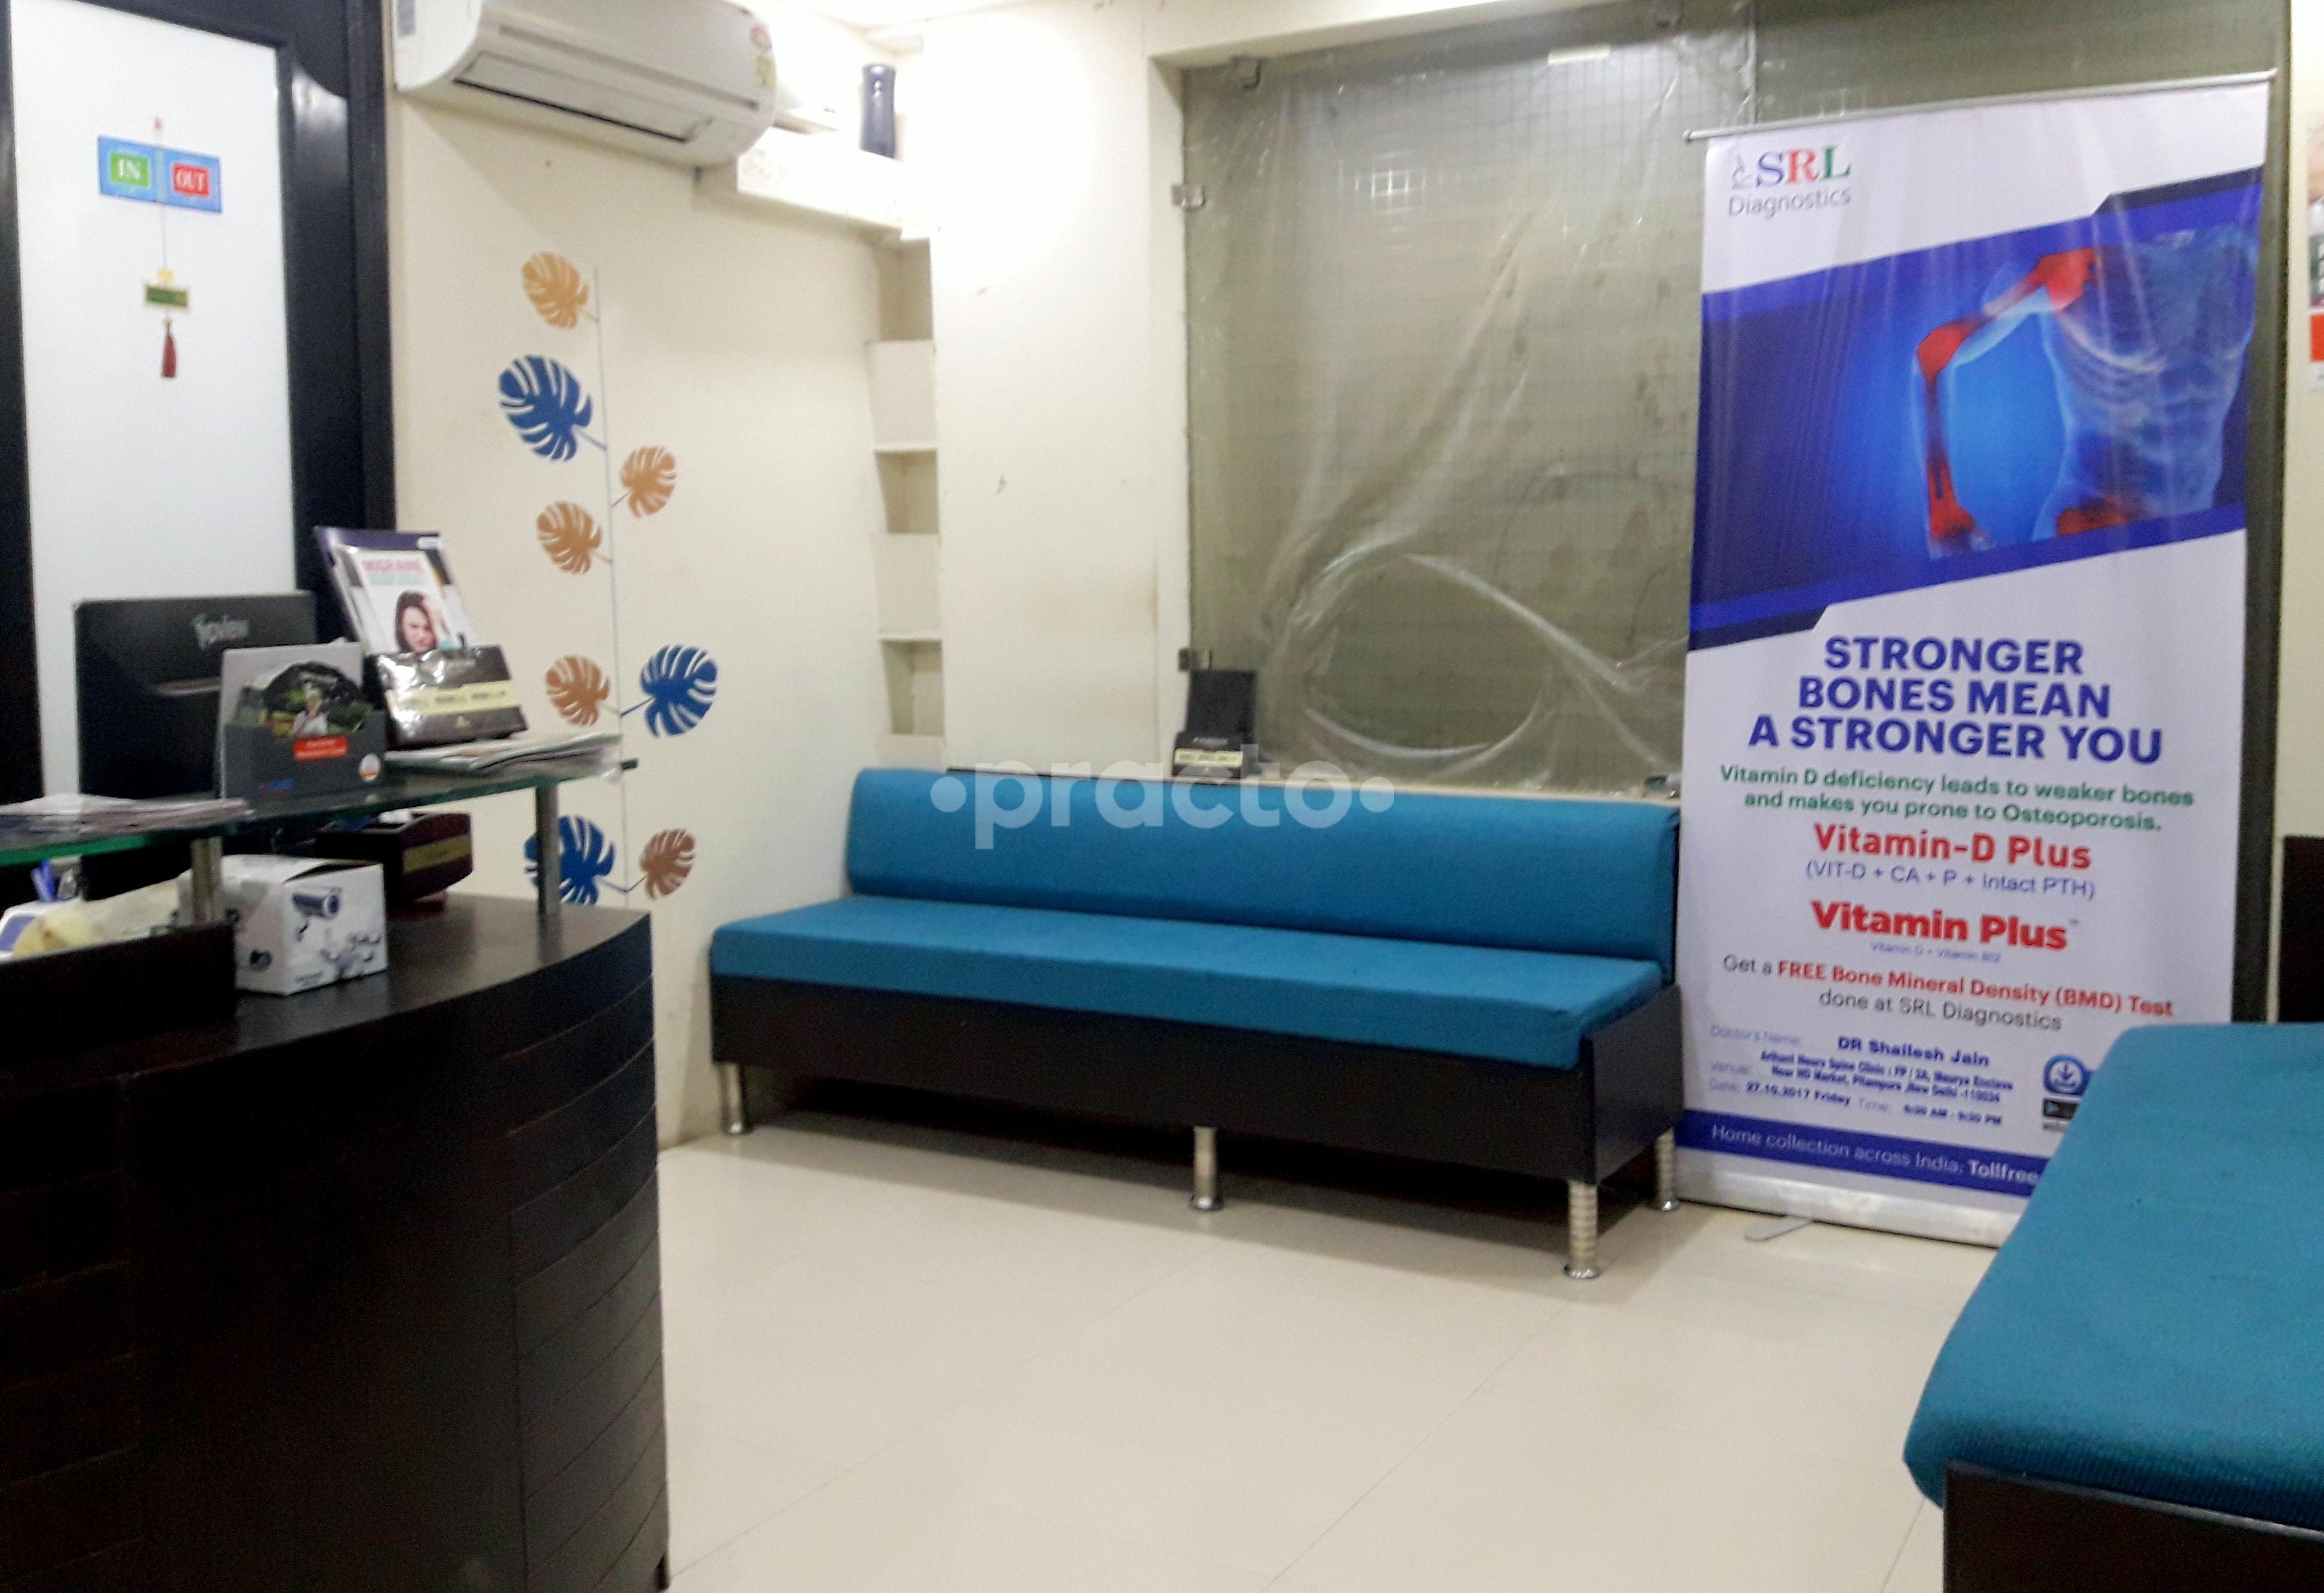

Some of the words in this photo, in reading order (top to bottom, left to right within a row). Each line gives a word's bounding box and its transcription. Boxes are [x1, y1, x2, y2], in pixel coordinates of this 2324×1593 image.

[118, 159, 143, 181] IN
[175, 168, 206, 193] OUT
[1755, 146, 1852, 187] SRL
[1729, 188, 1851, 220] Diagnostics
[1824, 636, 2083, 675] STRONGER
[1799, 676, 1955, 712] BONES
[1968, 681, 2111, 719] MEAN
[1748, 714, 1779, 747] A
[1791, 716, 2045, 759] STRONGER
[2060, 725, 2162, 765] YOU
[1721, 765, 1798, 784] Vitamin
[1804, 768, 1819, 784] D
[1824, 768, 1935, 795] deficiency
[1941, 774, 2000, 795] leads
[2006, 780, 2029, 796] to
[2035, 782, 2117, 801] weaker
[2122, 783, 2195, 806] bones
[1745, 790, 1783, 808] and
[1789, 793, 1855, 812] makes
[1861, 799, 1899, 816] you
[1905, 801, 1968, 819] prone
[1974, 804, 1997, 821] to
[2003, 803, 2162, 832] Osteoporosis.
[1813, 822, 1995, 863] Vitamin-D
[2007, 835, 2091, 870] Plus
[1805, 860, 1866, 879] (VIT-D
[1891, 865, 1921, 883] CA
[1943, 869, 1957, 886] P
[1983, 873, 2036, 893] Intact
[2043, 876, 2096, 900] PTH)
[1811, 900, 1968, 942] Vitamin
[1980, 913, 2067, 950] Plus
[1871, 942, 1913, 953] Vitamin
[1938, 948, 1979, 959] Vitamin
[1723, 954, 1757, 974] Get
[1762, 961, 1772, 976] a
[1778, 960, 1827, 980] FREE
[1833, 965, 1882, 986] Bone
[1888, 970, 1965, 995] Mineral
[1970, 978, 2049, 1006] Density
[2056, 986, 2123, 1015] (BMD)
[2129, 994, 2173, 1017] Test
[1819, 988, 1869, 1010] done
[1875, 996, 1893, 1013] at
[1899, 997, 1936, 1018] SRL
[1943, 1001, 2062, 1031] Diagnostics
[1838, 1035, 1861, 1051] DR
[1869, 1039, 1944, 1061] Shailesh
[1951, 1048, 1990, 1067] Jain
[1813, 1090, 1851, 1107] Friday
[1712, 1124, 1763, 1146] Home
[1765, 1133, 1851, 1158] collection
[1854, 1146, 1911, 1167] across
